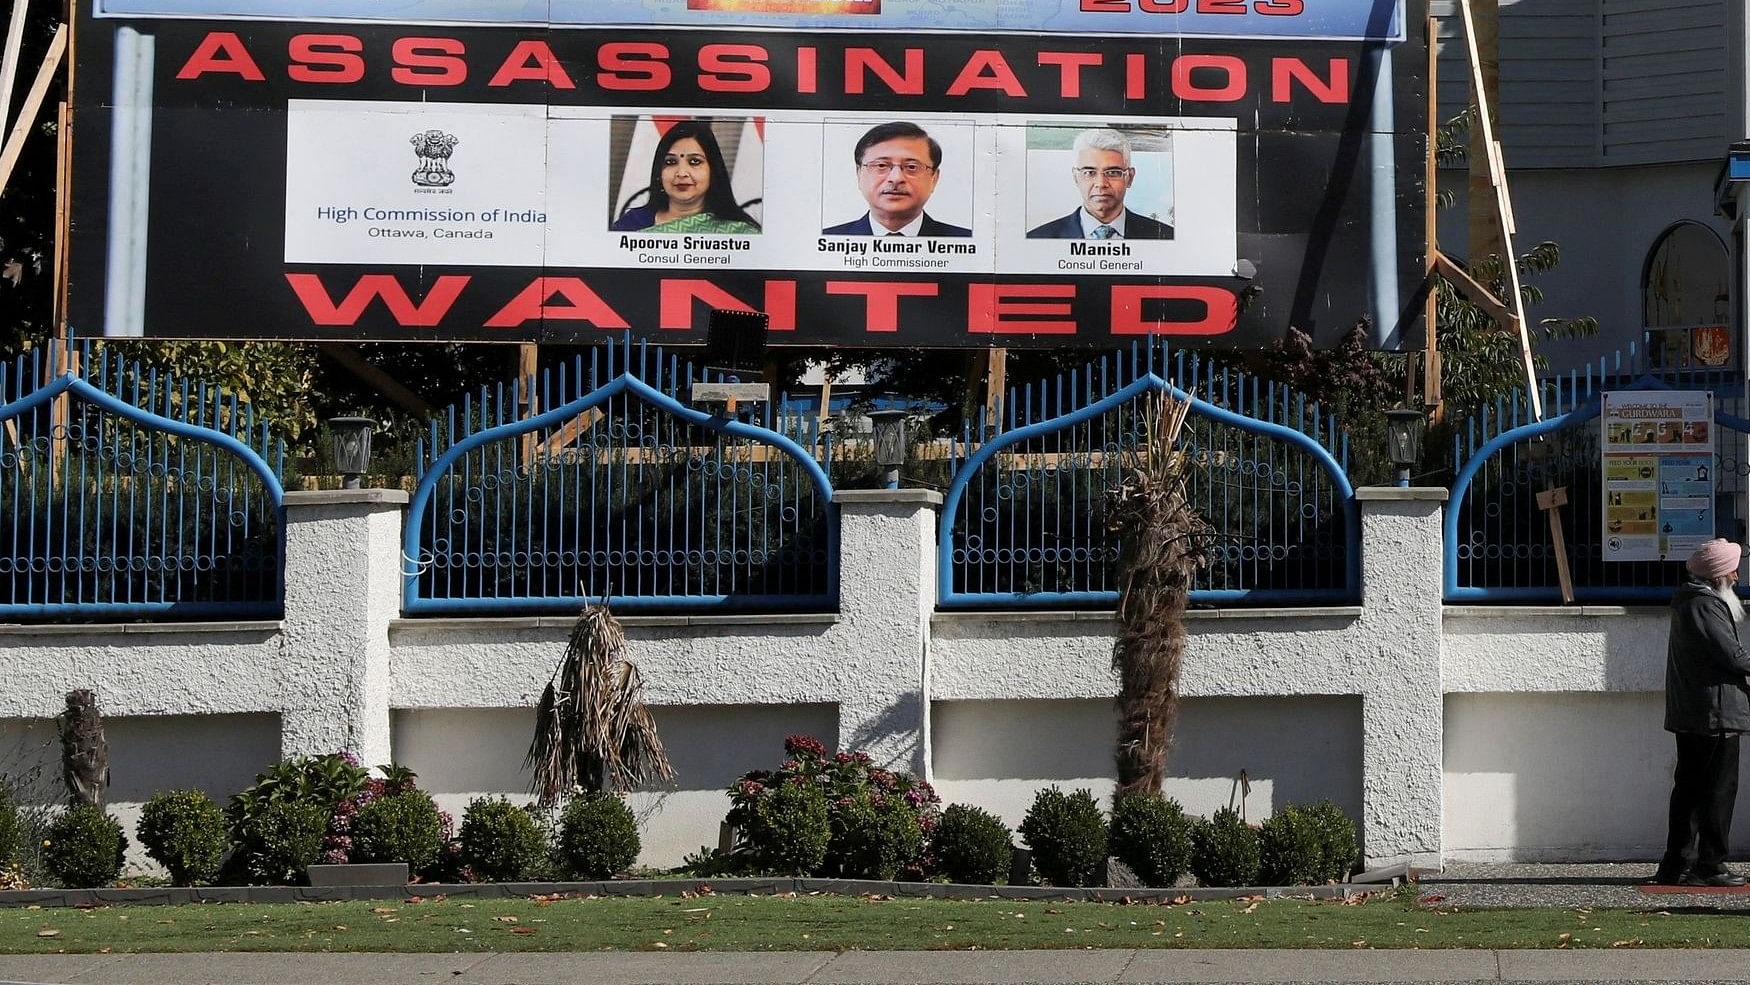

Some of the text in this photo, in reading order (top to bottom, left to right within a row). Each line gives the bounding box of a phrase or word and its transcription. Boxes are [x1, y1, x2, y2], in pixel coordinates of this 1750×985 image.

[176, 32, 1349, 104] ASSASSINATION
[317, 205, 547, 224] High Commission of India
[367, 226, 494, 241] Ottawa, Canada
[619, 235, 751, 254] Apoorva Srivastva
[818, 237, 977, 257] Sanjay Kumar Verma
[1070, 242, 1131, 258] Manish
[637, 253, 732, 265] Consul General
[844, 256, 949, 269] High Commissioner
[1058, 259, 1144, 272] Consul General
[284, 274, 1238, 336] WANTED
[1621, 409, 1676, 418] GURDWARA
